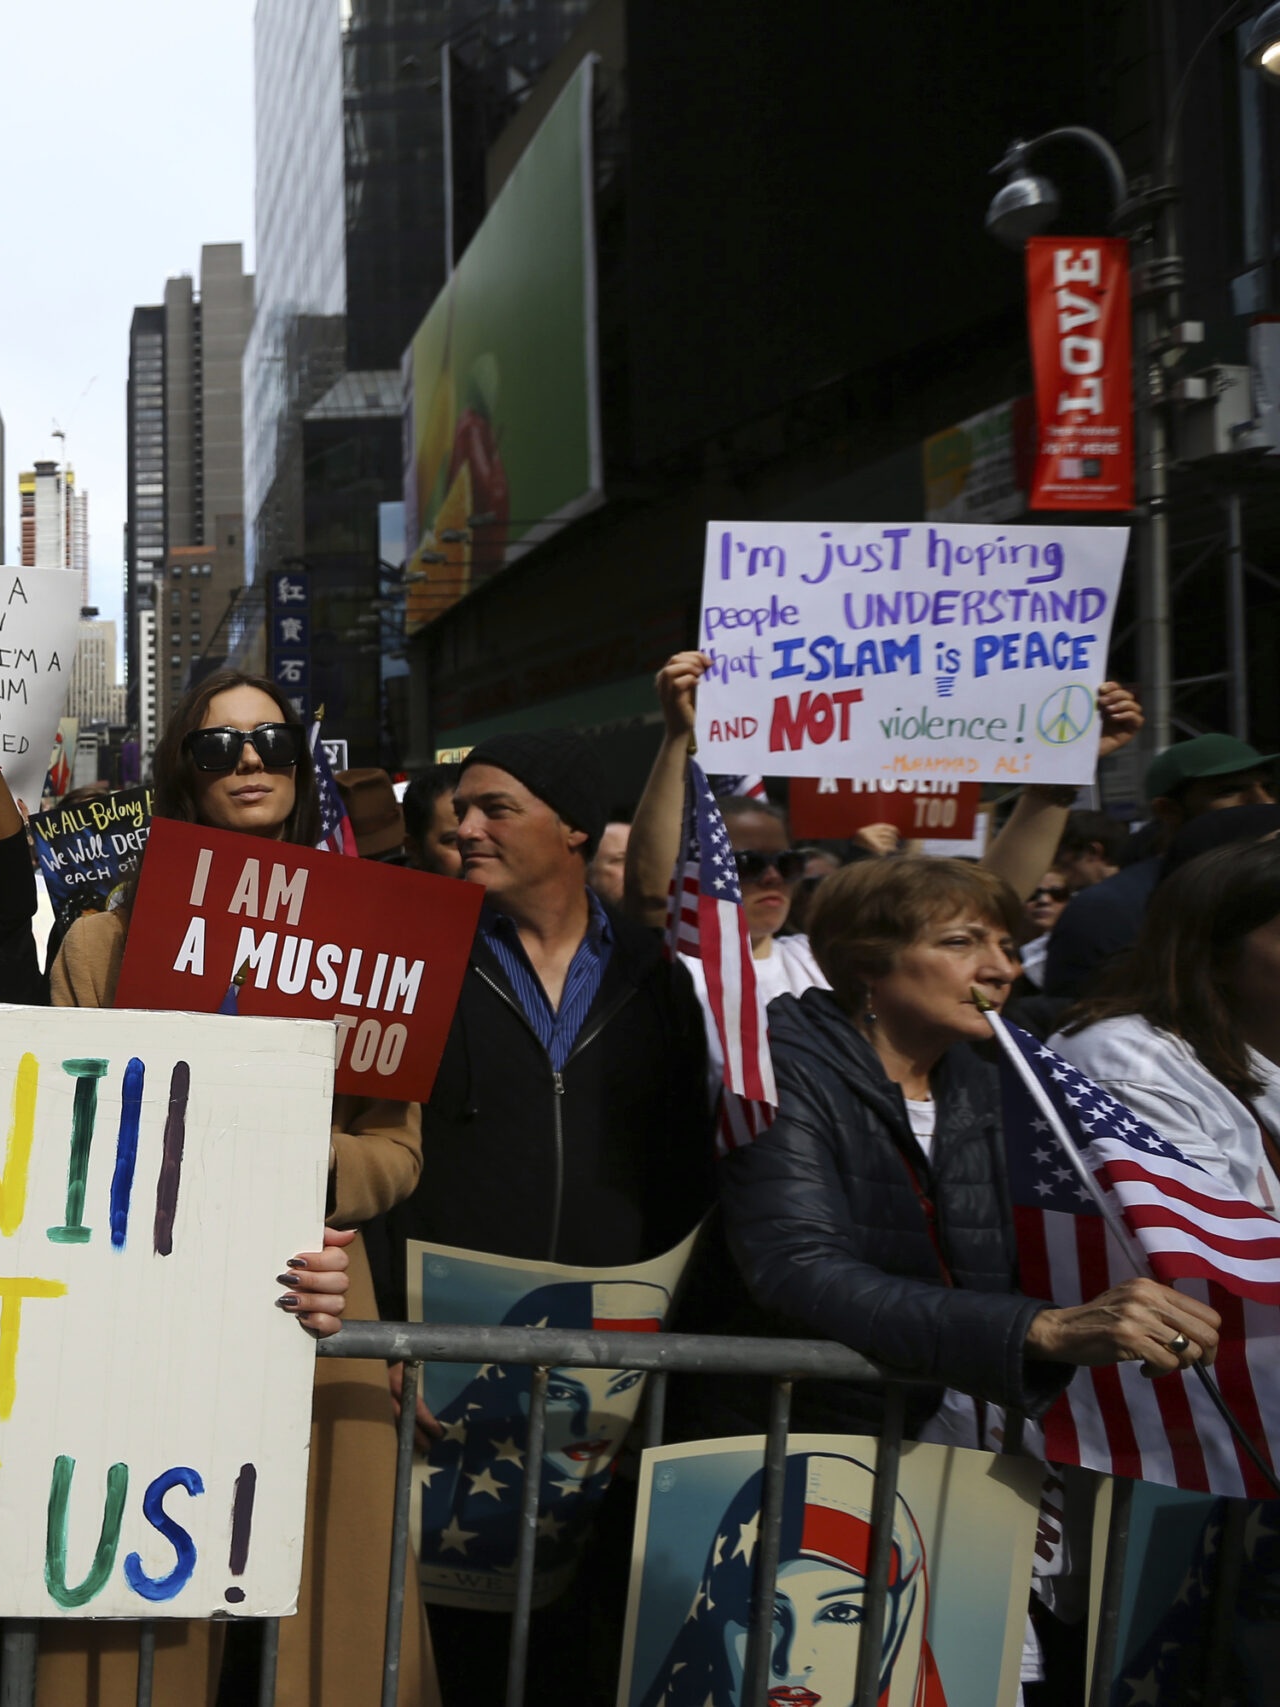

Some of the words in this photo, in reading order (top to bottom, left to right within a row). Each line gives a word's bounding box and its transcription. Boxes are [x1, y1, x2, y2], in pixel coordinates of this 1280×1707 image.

[1053, 248, 1104, 416] LOVE
[721, 531, 786, 580] I'm
[928, 528, 1065, 585] hoping
[8, 576, 27, 605] A
[704, 594, 801, 641] people
[843, 587, 1108, 630] UNDERSTAND
[47, 651, 61, 672] A
[770, 633, 921, 682] ISLAM
[934, 641, 962, 675] is
[973, 631, 1098, 678] PEACE
[708, 716, 759, 742] AND
[769, 688, 864, 752] NOT
[35, 816, 61, 841] We
[61, 809, 92, 835] ALL
[88, 796, 144, 830] Belong
[913, 798, 958, 828] TOO
[41, 847, 69, 872] We
[189, 848, 213, 907] I
[227, 858, 309, 926] AM
[173, 916, 206, 976] A
[230, 926, 425, 1015] MUSLIM
[334, 1013, 408, 1076] TOO
